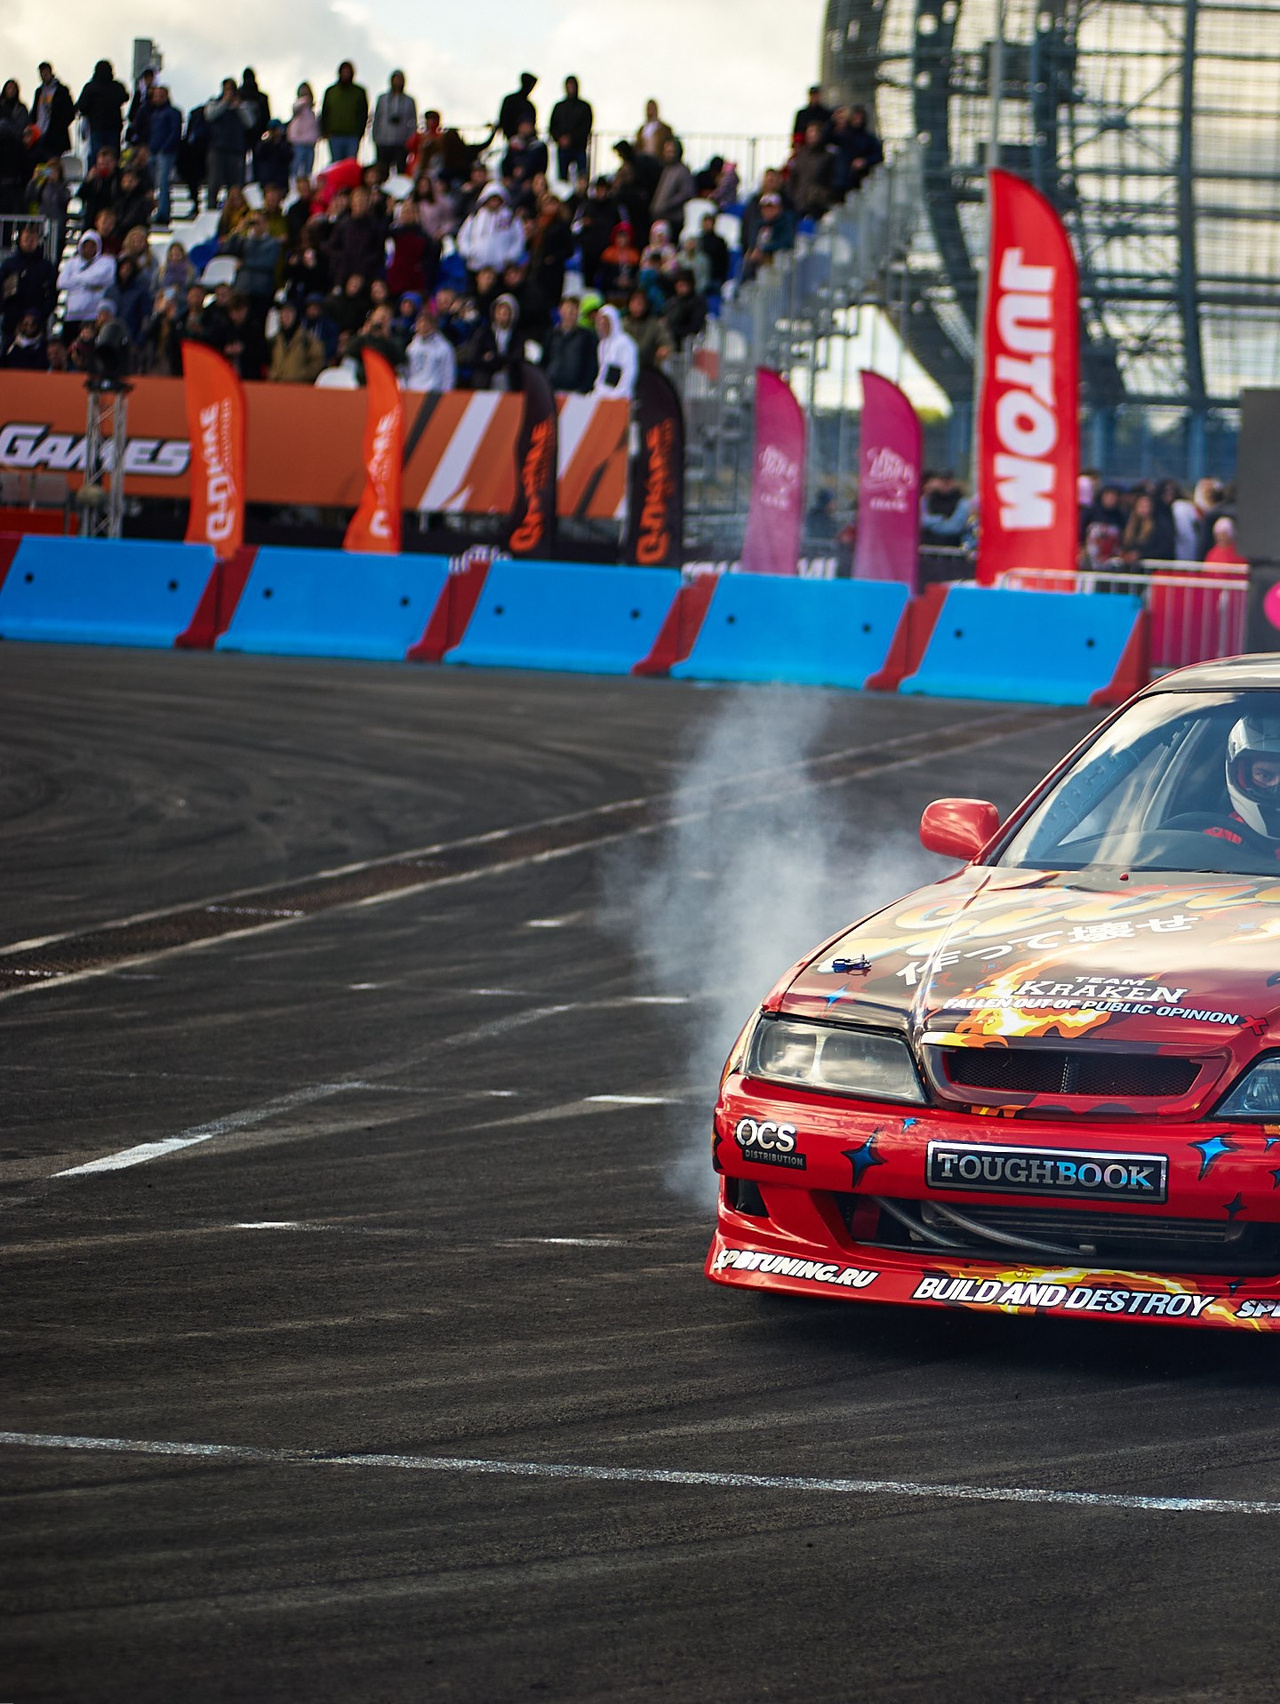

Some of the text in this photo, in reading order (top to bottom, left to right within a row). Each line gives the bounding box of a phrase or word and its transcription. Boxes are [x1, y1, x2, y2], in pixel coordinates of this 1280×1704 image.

[1012, 980, 1188, 1003] KRAKEN
[1075, 976, 1147, 987] TEAM
[943, 998, 1240, 1026] FALLEN OUT OF PUBLIC OPINION
[736, 1118, 796, 1152] OCS
[744, 1149, 804, 1166] DISTRIBUTION
[937, 1152, 1154, 1191] TOUGHBOOK
[713, 1250, 878, 1288] SPBTUNING.RU
[912, 1276, 1215, 1318] BUILD AND DESTROY
